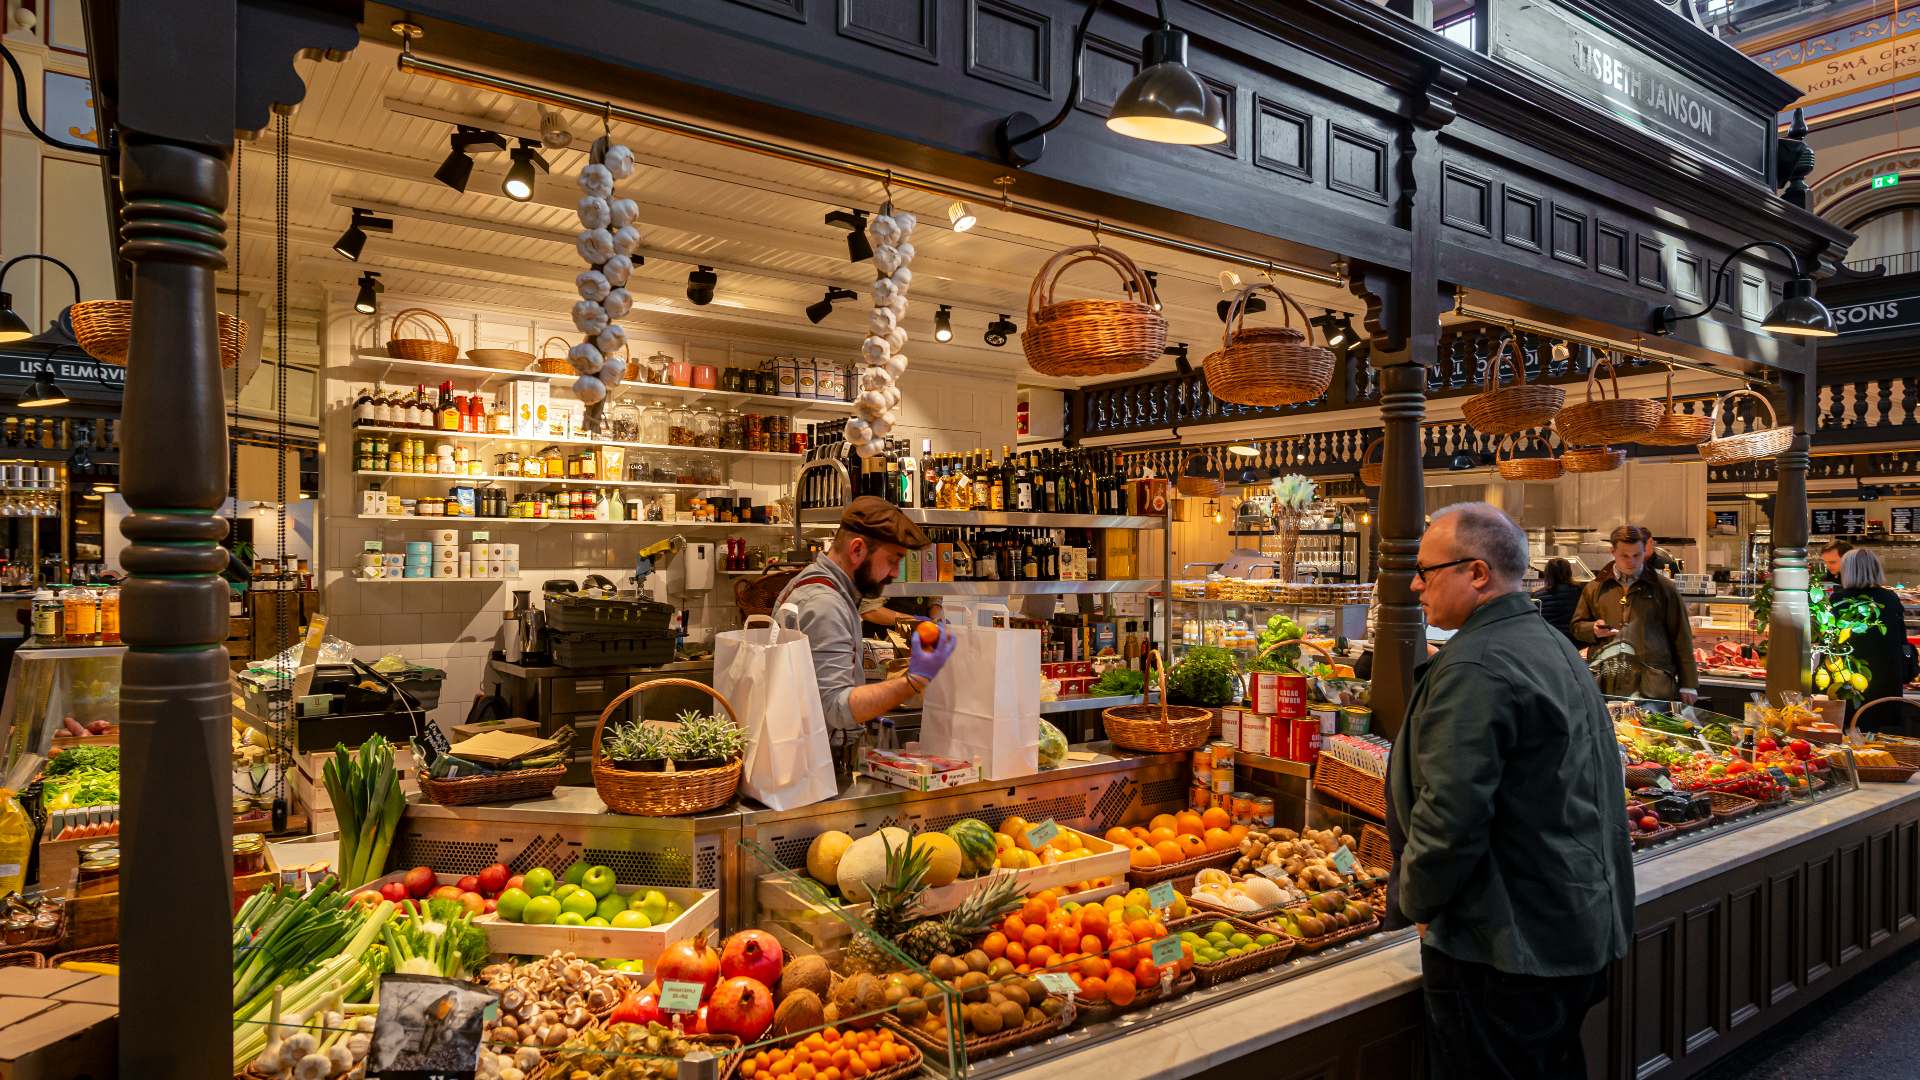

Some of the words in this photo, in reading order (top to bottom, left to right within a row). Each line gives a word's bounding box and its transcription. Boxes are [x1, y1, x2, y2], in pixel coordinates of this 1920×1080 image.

[1807, 73, 1856, 93] KOKA
[1867, 55, 1920, 77] OCKS
[1647, 79, 1713, 137] JANSON
[20, 360, 56, 375] LISA
